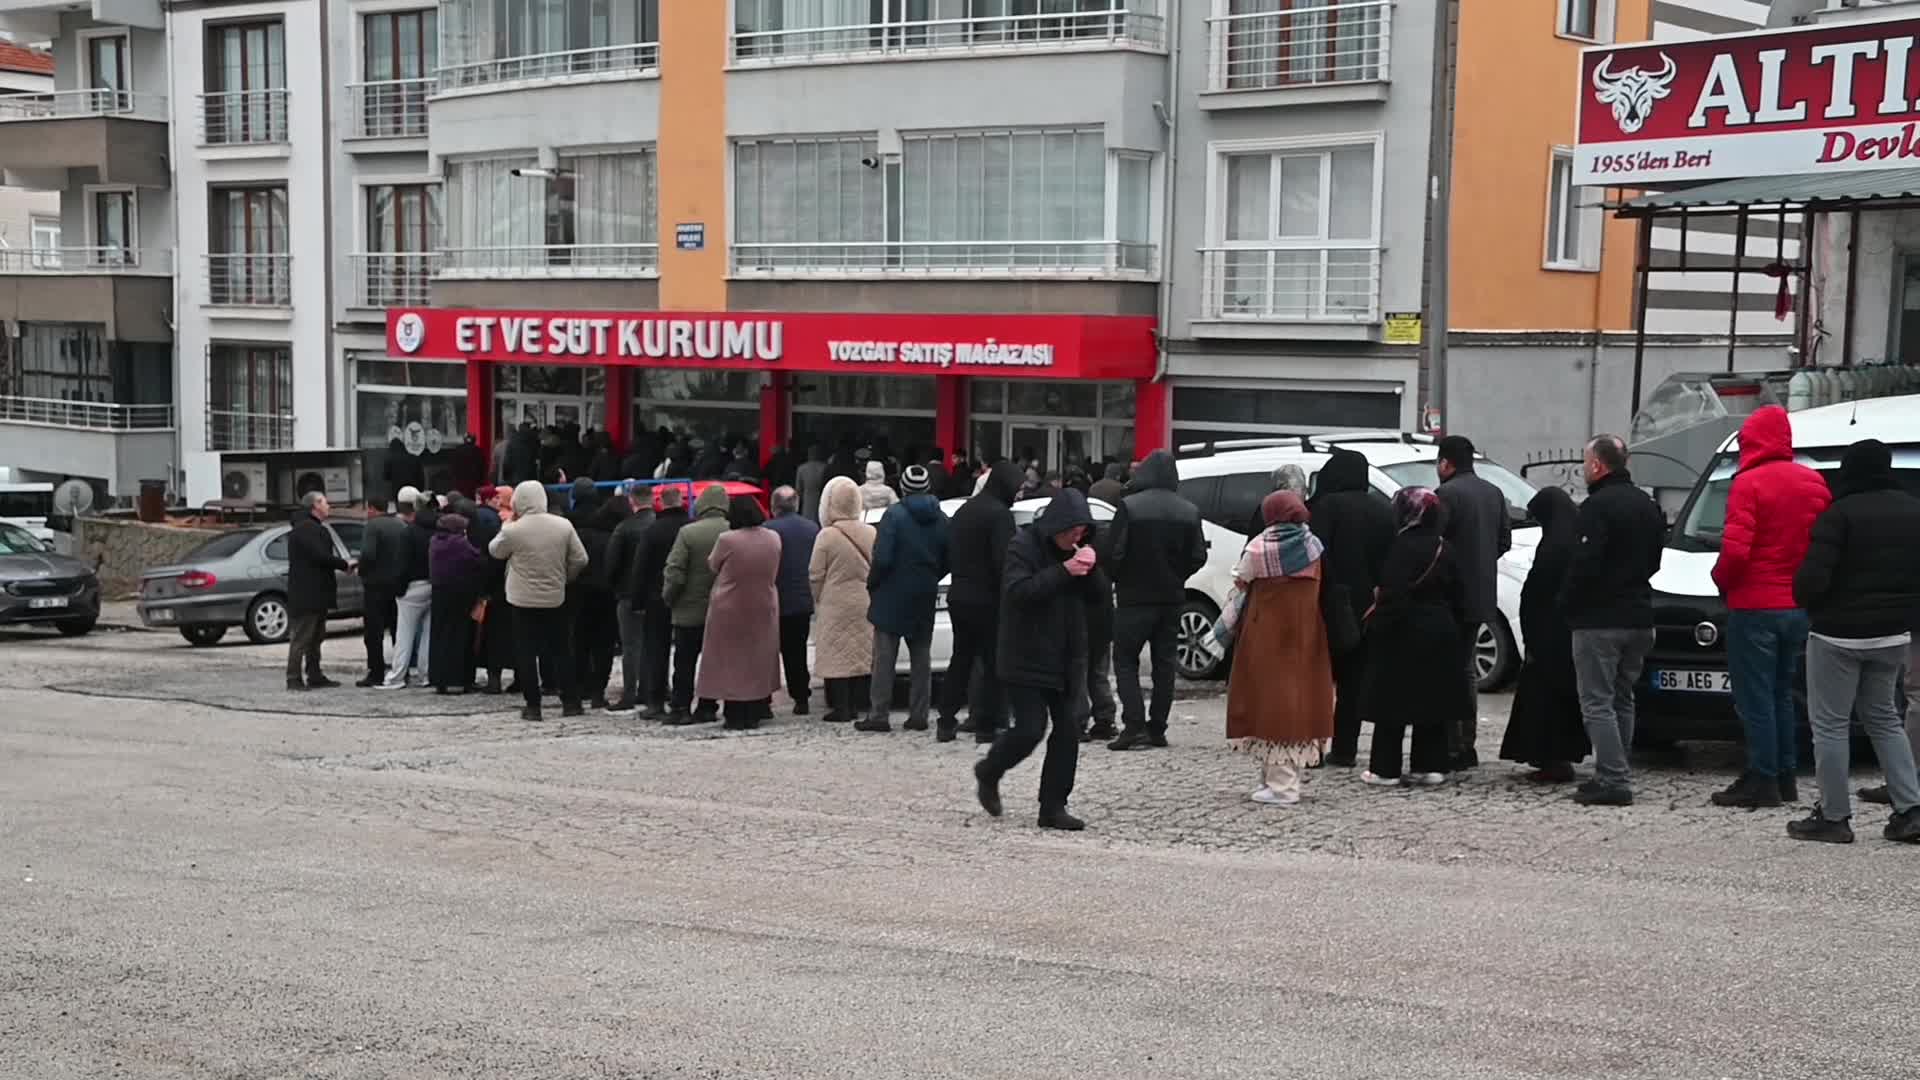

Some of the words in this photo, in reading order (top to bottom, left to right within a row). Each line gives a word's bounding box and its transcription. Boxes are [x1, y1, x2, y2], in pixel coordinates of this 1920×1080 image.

[1688, 36, 1920, 128] ALTI
[1590, 151, 1669, 173] 1955'den
[1672, 149, 1713, 168] Beri
[456, 317, 497, 352] ET
[500, 317, 543, 353] VE
[548, 318, 613, 355] SÜT
[618, 319, 784, 360] KURUMU
[827, 341, 898, 362] YOZGAT
[899, 342, 952, 367] SATIŞ
[955, 338, 1054, 365] MAĞAZASI
[1660, 672, 1677, 688] 66
